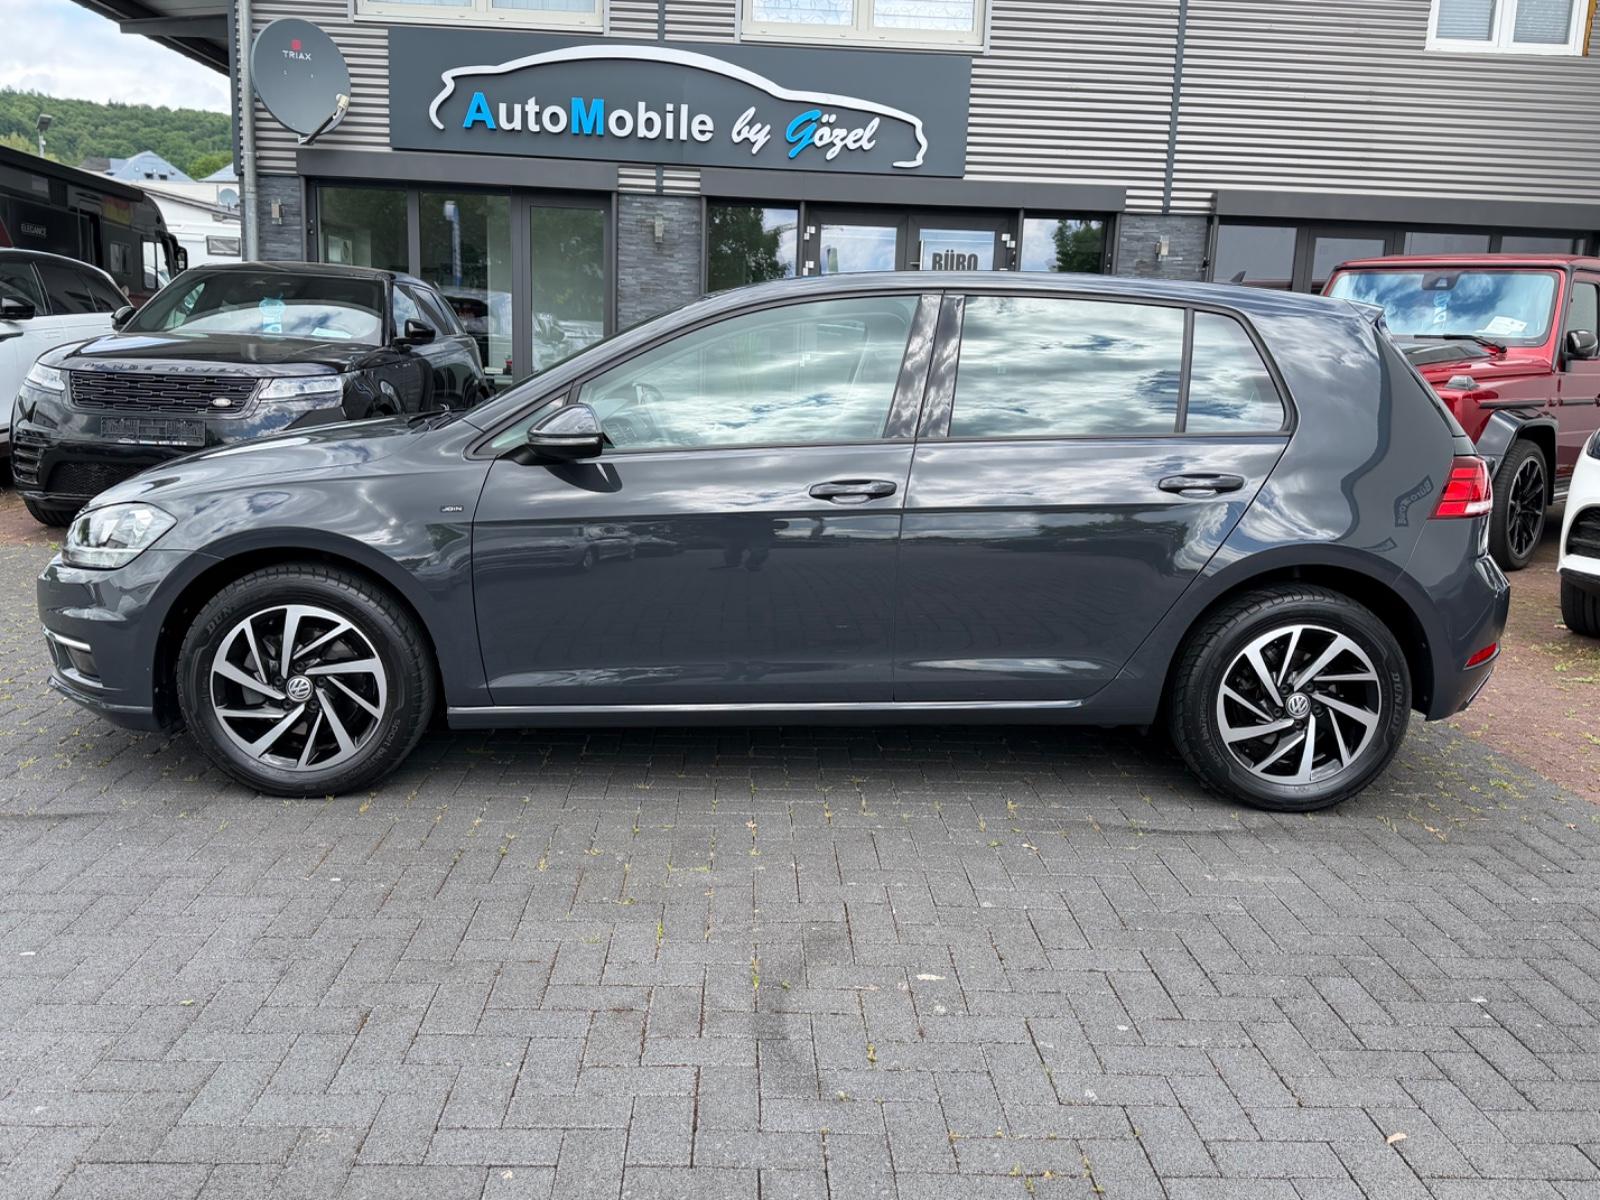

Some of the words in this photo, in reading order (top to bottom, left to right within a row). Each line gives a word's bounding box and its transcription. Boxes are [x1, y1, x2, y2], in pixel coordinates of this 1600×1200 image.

[282, 50, 312, 60] TRIAX
[463, 92, 715, 142] AutoMobile
[731, 106, 771, 154] by
[785, 109, 880, 160] Gözel
[932, 249, 978, 271] BÜRO
